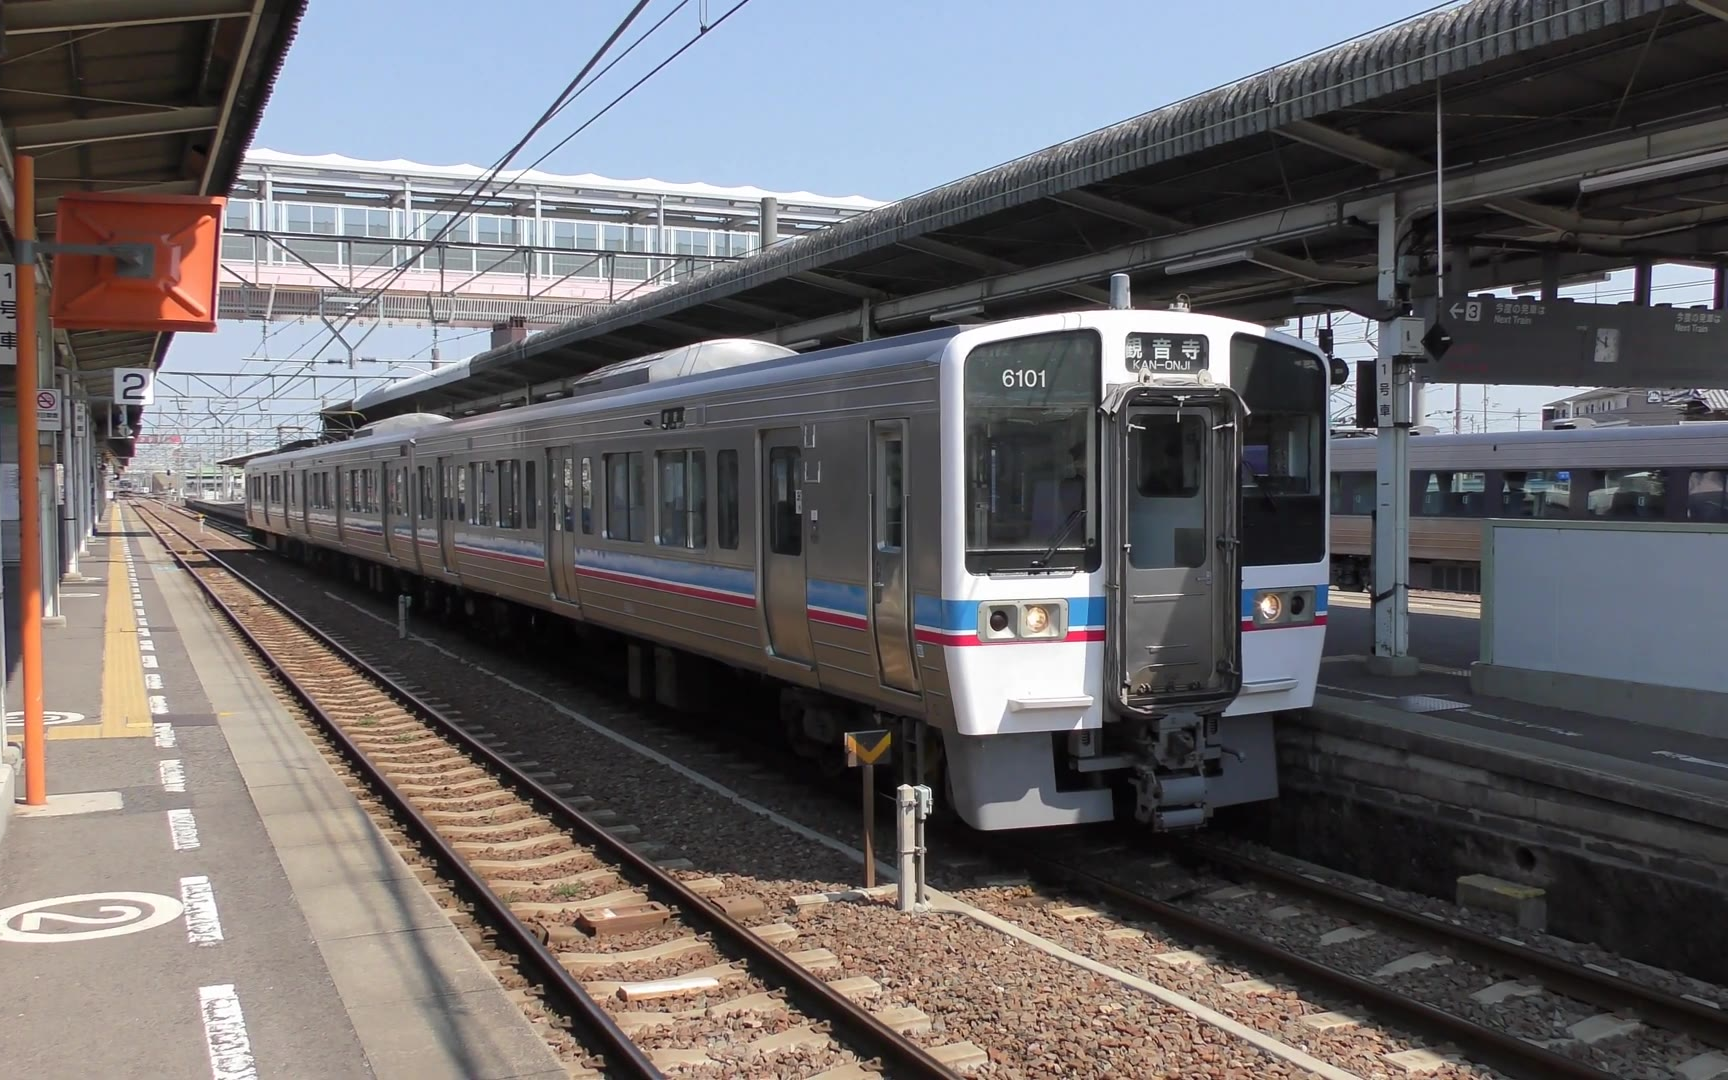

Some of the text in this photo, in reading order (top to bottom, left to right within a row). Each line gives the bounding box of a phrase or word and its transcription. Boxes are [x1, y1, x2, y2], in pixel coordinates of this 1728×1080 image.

[1467, 304, 1479, 319] 3
[1494, 315, 1531, 325] Next Train
[1674, 324, 1708, 333] Next Train
[1126, 337, 1201, 360] 観音寺
[1132, 360, 1191, 371] KAN-ONJI
[122, 373, 146, 400] 2
[1002, 369, 1046, 388] 6101
[1380, 364, 1390, 416] 1号車
[21, 905, 141, 931] 2
